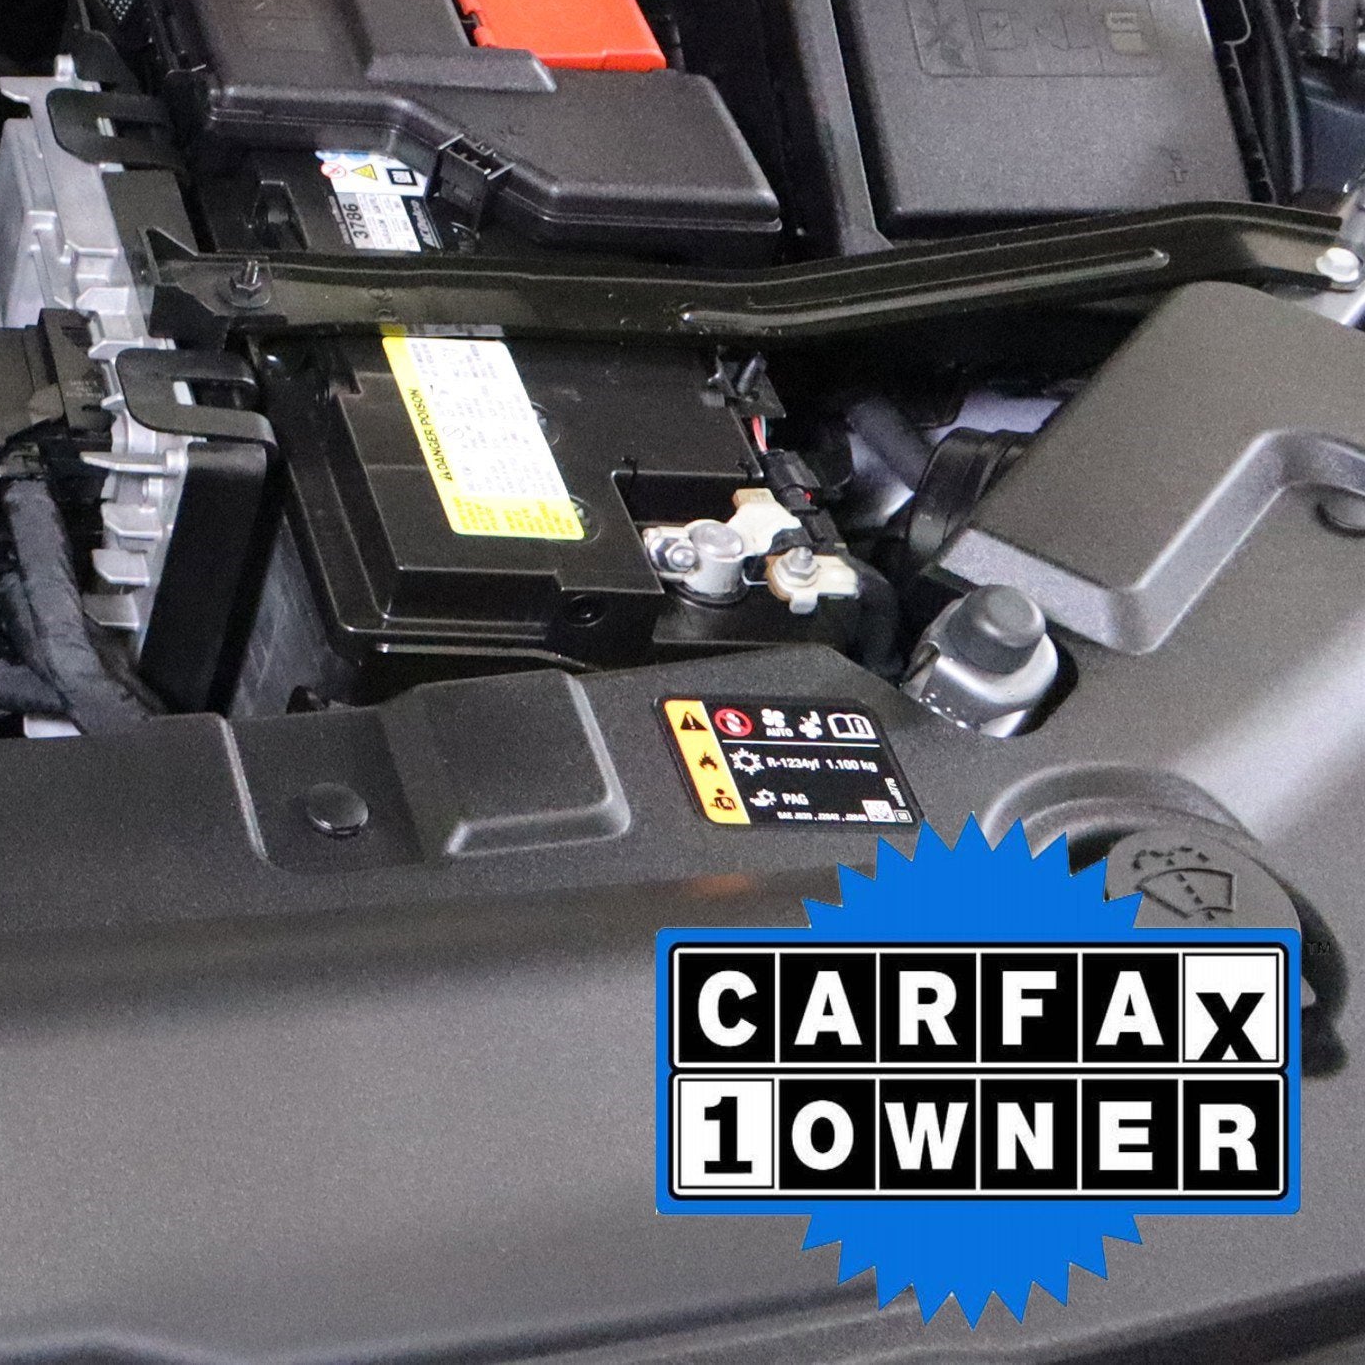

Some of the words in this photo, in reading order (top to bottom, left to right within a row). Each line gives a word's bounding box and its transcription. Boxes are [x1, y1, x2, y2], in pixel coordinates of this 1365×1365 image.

[342, 203, 369, 239] 3786
[408, 388, 432, 426] POISON
[423, 427, 451, 470] DANGER
[766, 727, 794, 738] AUTO
[765, 757, 820, 771] R-1234yf
[825, 758, 859, 770] 1.100
[860, 760, 878, 773] kg
[781, 792, 810, 806] PAG
